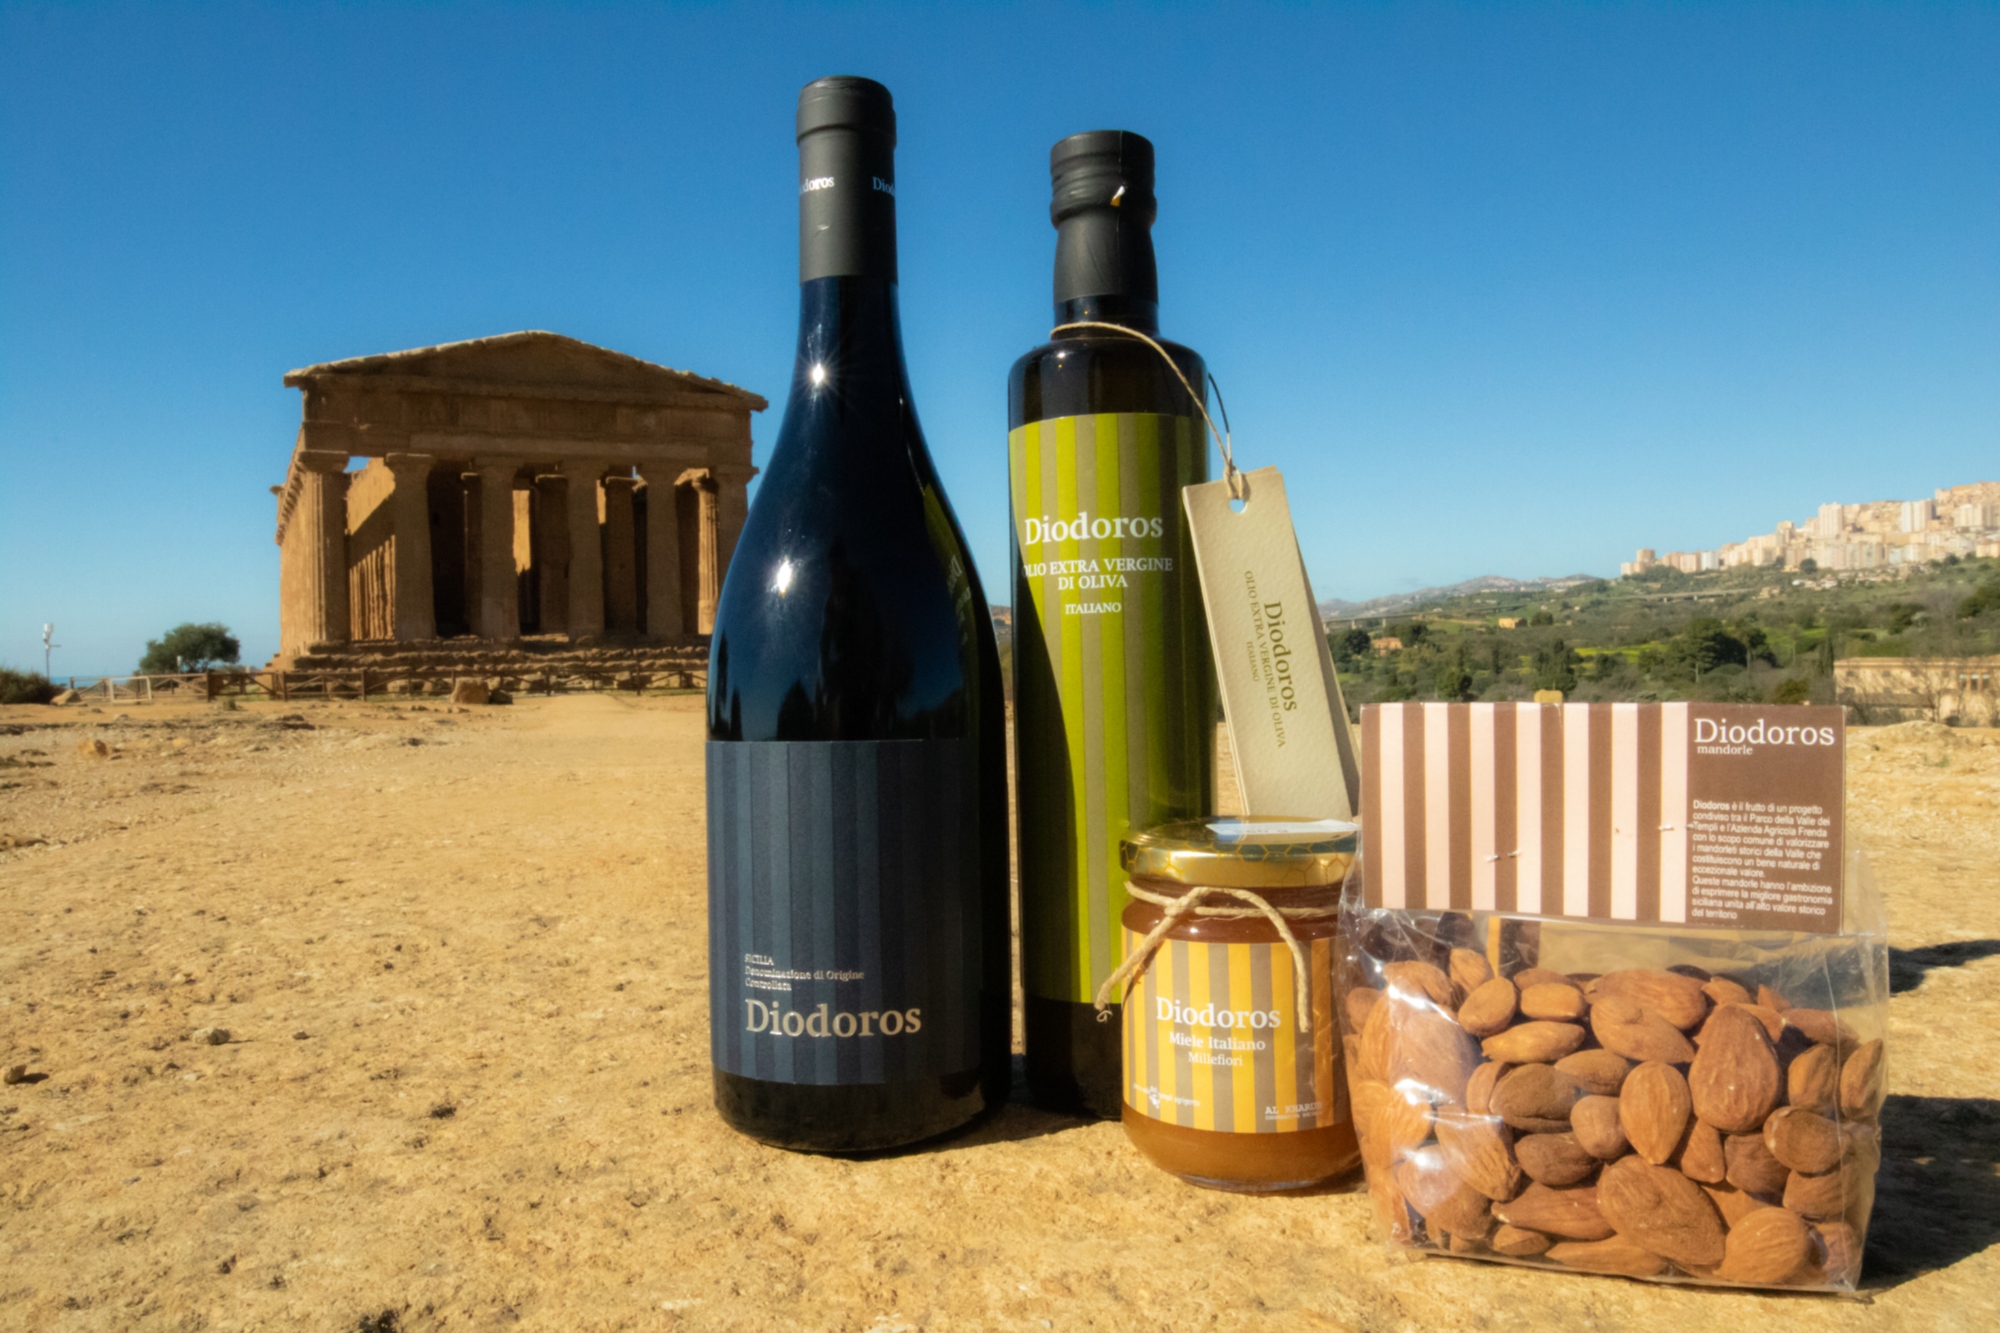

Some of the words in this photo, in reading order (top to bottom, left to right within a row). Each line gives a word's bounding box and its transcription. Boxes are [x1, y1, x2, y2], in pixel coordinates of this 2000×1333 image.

[1025, 511, 1163, 545] Diodoros
[1023, 563, 1047, 577] OLIO
[1050, 559, 1099, 575] EXTRA
[1104, 558, 1173, 572] VERGINE
[1058, 577, 1074, 590] DI
[1078, 574, 1128, 589] OLIVA
[1244, 570, 1257, 599] OLIO
[1065, 602, 1122, 615] ITALIANO
[1251, 602, 1263, 640] EXTRA
[1246, 641, 1259, 682] ITALIANO
[1264, 601, 1297, 711] Diodoros
[1259, 641, 1276, 693] VERGINE
[1269, 696, 1278, 710] DI
[1272, 712, 1286, 749] OLIVA
[1694, 718, 1835, 746] Diodoros
[1697, 744, 1753, 755] mandorle
[1693, 800, 1730, 811] Diodoros
[1731, 801, 1737, 811] è
[1739, 802, 1743, 811] il
[1745, 802, 1766, 812] frutto
[1767, 803, 1775, 813] di
[1776, 805, 1787, 813] un
[1789, 805, 1823, 816] progetto
[1693, 812, 1729, 822] condiviso
[1731, 813, 1742, 822] tra
[1743, 813, 1748, 822] il
[1750, 813, 1773, 824] Parco
[1775, 815, 1794, 825] della
[1796, 815, 1816, 826] Valle
[1817, 816, 1831, 826] dei
[1693, 821, 1718, 832] Templi
[1720, 824, 1725, 832] e
[1727, 823, 1763, 834] l'Azienda
[1764, 825, 1796, 837] Agricola
[1798, 826, 1827, 838] Frenda
[1693, 833, 1707, 841] con
[1709, 832, 1716, 842] lo
[1718, 834, 1741, 845] scopo
[1743, 836, 1774, 846] comune
[1776, 837, 1784, 846] di
[1786, 838, 1830, 849] valorizzare
[1739, 846, 1763, 856] storici
[1763, 847, 1783, 857] della
[1785, 848, 1805, 858] Valle
[1806, 850, 1822, 860] che
[1692, 854, 1742, 866] costituiscono
[1744, 858, 1754, 866] un
[1756, 857, 1776, 868] bene
[1778, 860, 1811, 870] naturale
[1812, 861, 1820, 870] di
[1692, 866, 1738, 876] eccezionale
[1740, 868, 1766, 878] valore.
[1692, 874, 1720, 886] Queste
[1721, 878, 1758, 889] mandorle
[1760, 880, 1785, 890] hanno
[1692, 886, 1699, 895] di
[1701, 887, 1740, 898] esprimere
[1741, 889, 1749, 898] la
[1750, 890, 1781, 903] migliore
[1782, 893, 1833, 905] gastronomia
[1692, 897, 1723, 908] siciliana
[1724, 899, 1744, 909] unita
[1772, 903, 1797, 914] valore
[1798, 904, 1826, 916] storico
[1692, 907, 1704, 917] del
[1705, 908, 1738, 920] territorio
[745, 953, 774, 966] SICILIA
[745, 965, 811, 980] Denominazione
[813, 970, 824, 979] di
[826, 970, 864, 981] Origine
[745, 978, 792, 991] Controllata
[745, 998, 922, 1038] Diodoros
[1156, 996, 1281, 1029] Diodoros
[1169, 1032, 1204, 1048] Miele
[1208, 1036, 1266, 1051] Italiano
[1188, 1051, 1243, 1067] Millefiori
